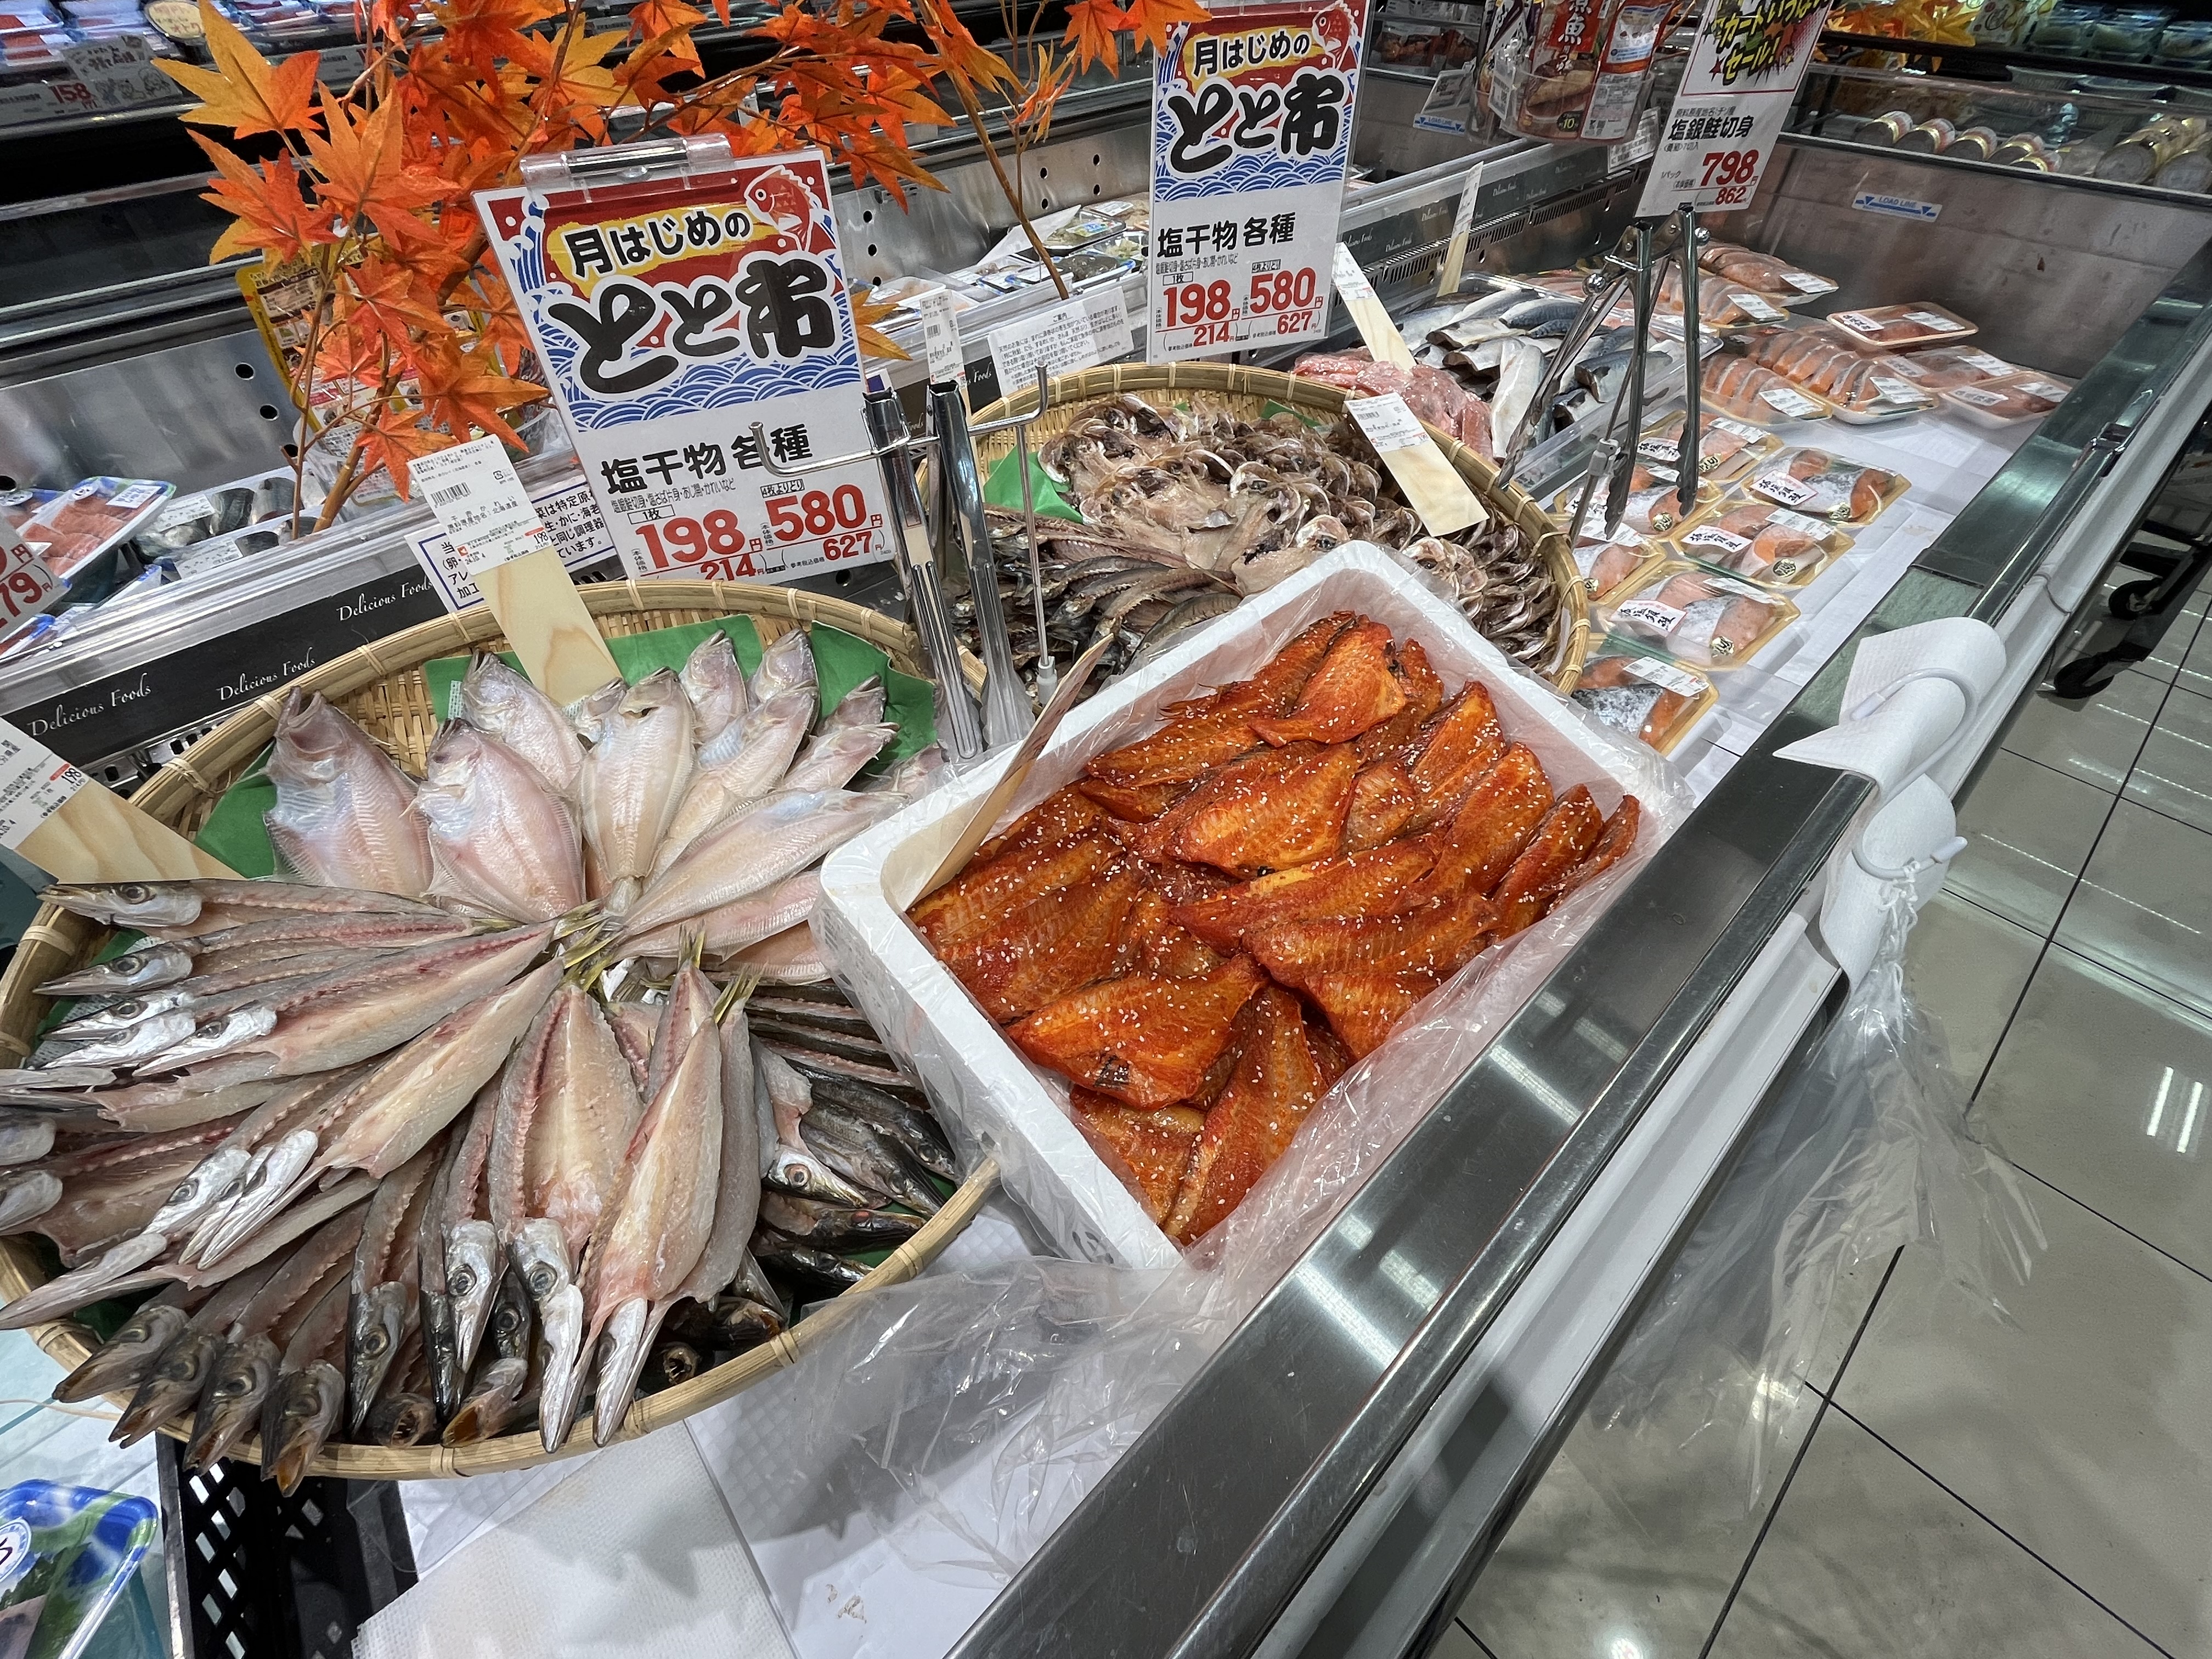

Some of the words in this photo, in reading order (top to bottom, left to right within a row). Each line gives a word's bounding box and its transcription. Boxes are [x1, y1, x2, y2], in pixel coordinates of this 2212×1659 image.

[1193, 30, 1310, 77] 月はじめの
[49, 82, 92, 104] 158
[1167, 74, 1345, 173] とと市
[1668, 115, 1754, 140] 塩銀鮭切身
[1879, 196, 1898, 205] LOAD
[1900, 200, 1917, 208] LINE
[564, 210, 752, 279] 月はじめの
[1172, 273, 1184, 284] 1枚
[548, 258, 836, 394] とと市
[973, 361, 992, 383] Foods
[441, 541, 455, 554] 当
[534, 489, 594, 520] 菜は特定原
[642, 509, 662, 521] 1枚
[533, 531, 549, 544] 198
[448, 571, 468, 585] アレ
[456, 582, 480, 599] 加工
[556, 537, 602, 558] ています。
[336, 592, 396, 621] Delicious
[401, 575, 433, 598] Foods
[216, 673, 278, 701] Delicious
[283, 647, 316, 676] Foods
[27, 704, 104, 736] Delicious
[111, 673, 151, 707] Foods
[61, 768, 82, 784] 198
